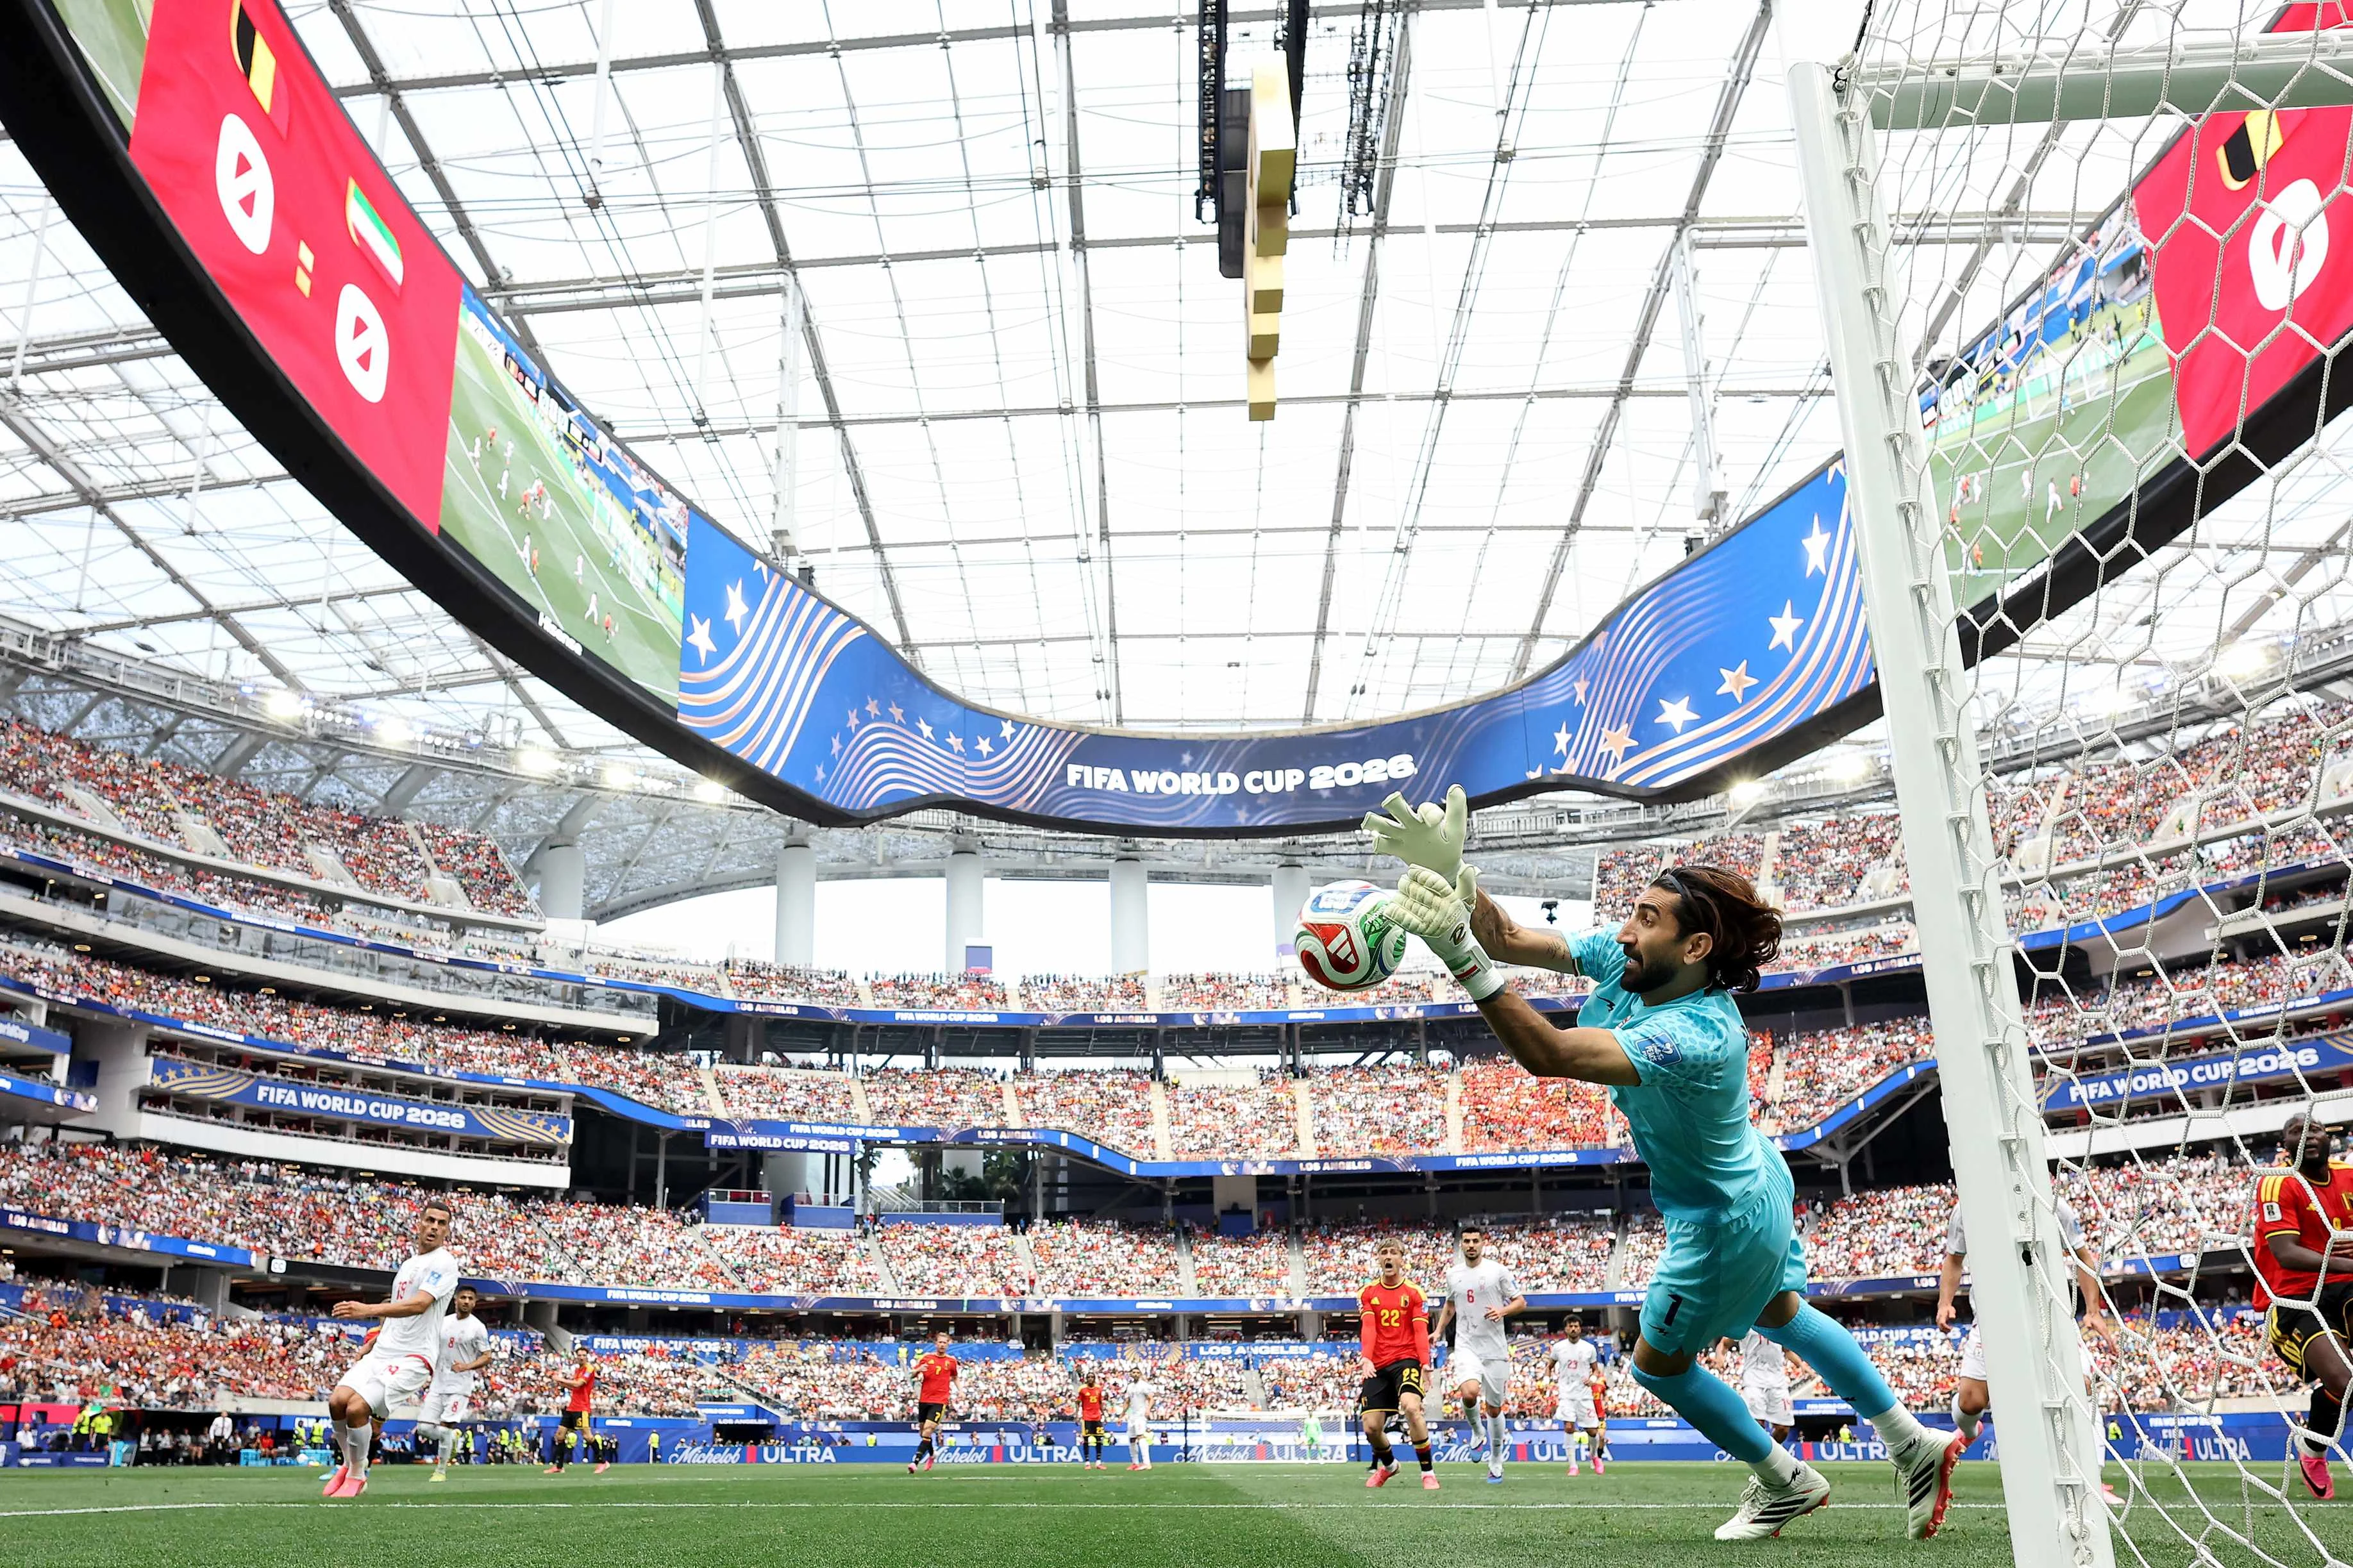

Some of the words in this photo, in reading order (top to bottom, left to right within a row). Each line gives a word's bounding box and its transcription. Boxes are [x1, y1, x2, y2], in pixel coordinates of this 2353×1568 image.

[1066, 763, 1128, 792] FIFA
[1132, 771, 1240, 795] WORLD
[1243, 769, 1305, 794] CUP
[1309, 754, 1415, 790] 2026
[1851, 963, 1873, 975] LOS
[2069, 1081, 2113, 1103] FIFA
[2114, 1066, 2188, 1096] WORLD
[2191, 1060, 2234, 1084] CUP
[2238, 1047, 2319, 1076] 2026
[257, 1085, 298, 1106] FIFA
[301, 1092, 367, 1115] WORLD
[369, 1101, 405, 1121] CUP
[406, 1107, 466, 1130] 2026
[710, 1134, 737, 1147] FIFA
[737, 1136, 783, 1149] WORLD
[783, 1138, 808, 1149] CUP
[808, 1139, 850, 1152] 2026
[1299, 1162, 1321, 1172] LOS
[1322, 1160, 1372, 1171] ANGELES
[1455, 1156, 1480, 1167] FIFA
[1517, 1154, 1541, 1165] CUP
[8, 1213, 28, 1228] LOS
[1467, 1289, 1475, 1303] 6
[1380, 1308, 1400, 1327] 22
[1663, 1293, 1683, 1327] 1
[448, 1337, 455, 1348] 8
[593, 1338, 620, 1349] FIFA
[1880, 1329, 1909, 1342] CUP
[1198, 1345, 1232, 1356] LOS
[1234, 1345, 1310, 1356] ANGELES
[1402, 1367, 1419, 1384] 22
[451, 1401, 458, 1413] 8
[667, 1443, 741, 1465] Michelob
[762, 1446, 836, 1464] ULTRA
[1009, 1445, 1084, 1463] ULTRA
[1819, 1442, 1890, 1461] ULTR
[2195, 1437, 2252, 1461] ULTRA
